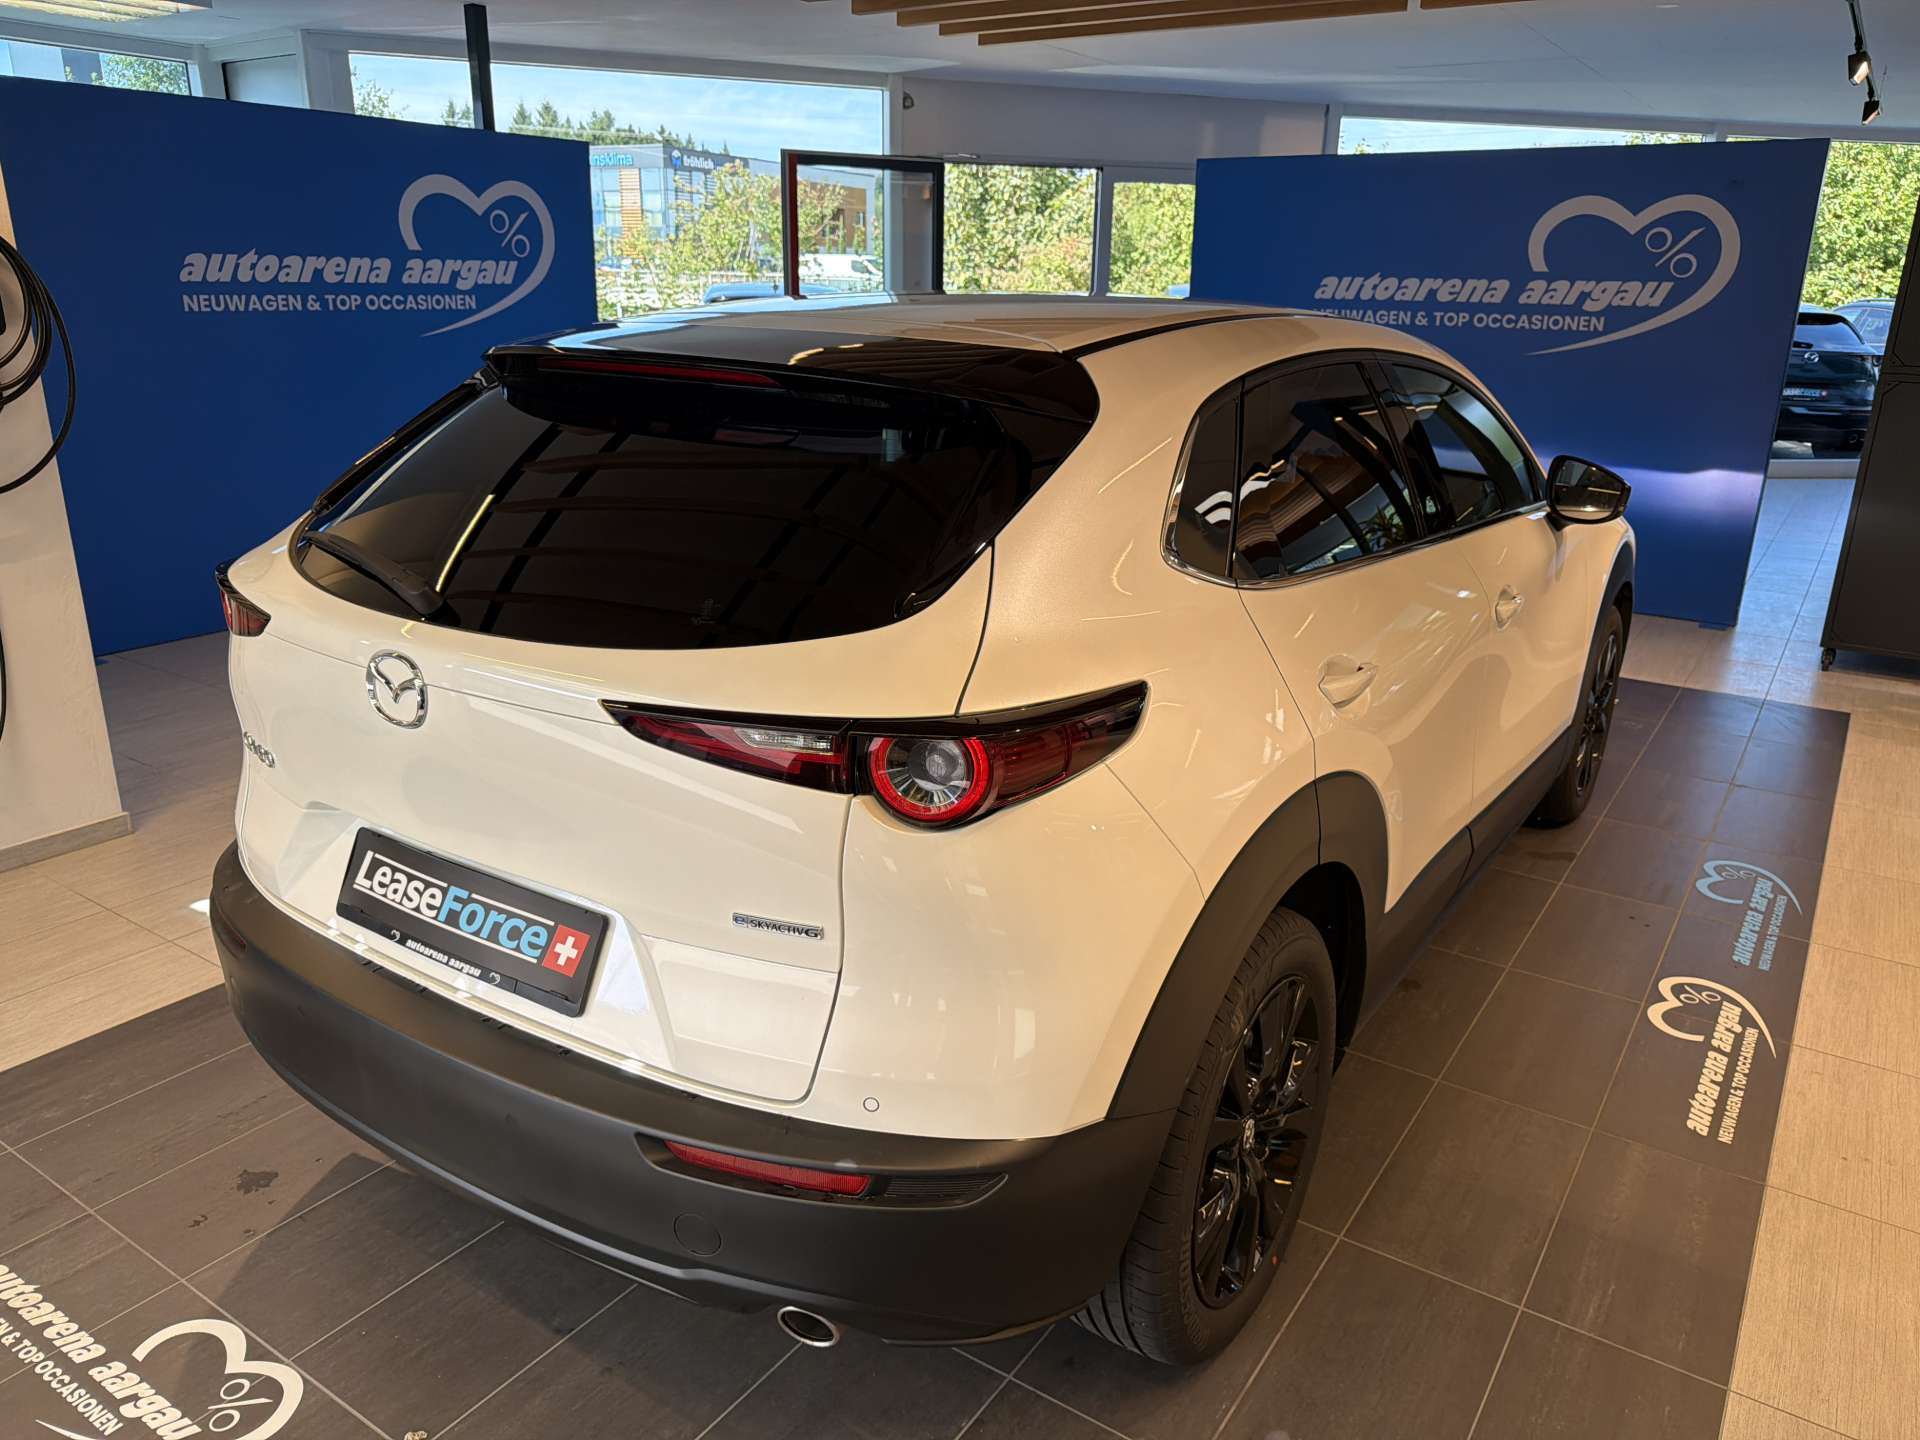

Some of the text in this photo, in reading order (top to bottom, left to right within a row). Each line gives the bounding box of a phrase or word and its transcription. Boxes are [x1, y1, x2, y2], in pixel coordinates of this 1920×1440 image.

[179, 248, 518, 291] autoarena aargau
[1314, 272, 1674, 311] autoarena aargau
[182, 293, 477, 313] NEUWAGEN & TOP OCCASIONEN
[1415, 311, 1429, 326] &
[1434, 311, 1469, 327] TOP
[1473, 313, 1605, 332] OCCASIONEN
[354, 850, 548, 958] LeaseForce
[405, 939, 481, 977] autoarena aargau
[1686, 1001, 1743, 1137] autoarena aargau
[1717, 1026, 1760, 1145] NEUWAGEN & TOP OCCASIONEN
[1, 1331, 124, 1437] & TOP OCCASIONEN
[88, 1361, 202, 1440] aargau
